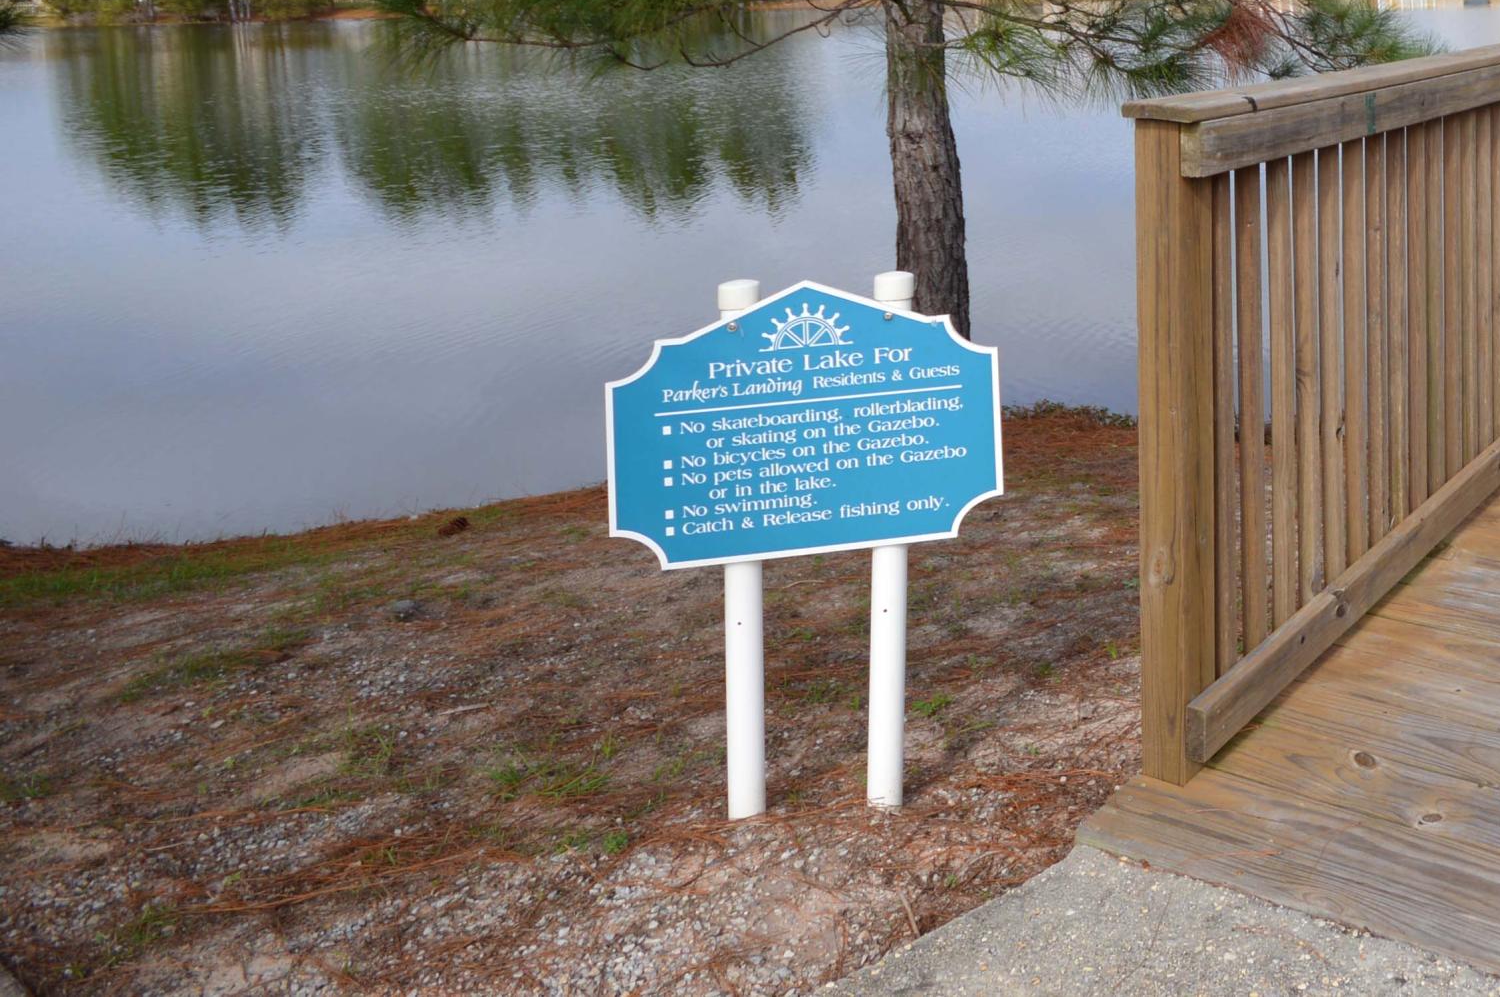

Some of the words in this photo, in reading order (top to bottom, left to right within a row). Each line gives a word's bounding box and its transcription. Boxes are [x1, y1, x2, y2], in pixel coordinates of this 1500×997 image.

[709, 358, 792, 379] Private
[803, 350, 864, 371] Lake
[874, 347, 912, 364] For
[662, 381, 728, 403] Parker's
[732, 377, 803, 396] Landing
[813, 371, 886, 389] Residents
[891, 370, 903, 381] &
[909, 365, 960, 379] Guests
[680, 421, 705, 434] No
[854, 396, 963, 418] rollerblading,
[706, 437, 724, 449] or
[732, 429, 797, 447] skating
[803, 426, 826, 439] on
[834, 422, 861, 436] the
[868, 416, 940, 433] Gazebo.
[681, 455, 706, 468] No
[713, 447, 786, 466] bicycles
[792, 445, 815, 458] on
[823, 441, 850, 454] the
[857, 434, 929, 451] Gazebo.
[681, 473, 707, 485] No
[713, 468, 752, 485] pets
[760, 458, 828, 478] allowed
[836, 457, 859, 470] on
[867, 453, 894, 467] the
[900, 446, 967, 463] Gazebo
[709, 488, 728, 500] or
[735, 484, 752, 497] in
[760, 480, 787, 495] the
[795, 476, 836, 491] lake.
[682, 506, 708, 518] No
[714, 494, 817, 515] swimming.
[682, 518, 733, 536] Catch
[741, 517, 754, 529] &
[763, 508, 832, 527] Release
[840, 500, 900, 518] fishing
[907, 496, 950, 512] only.
